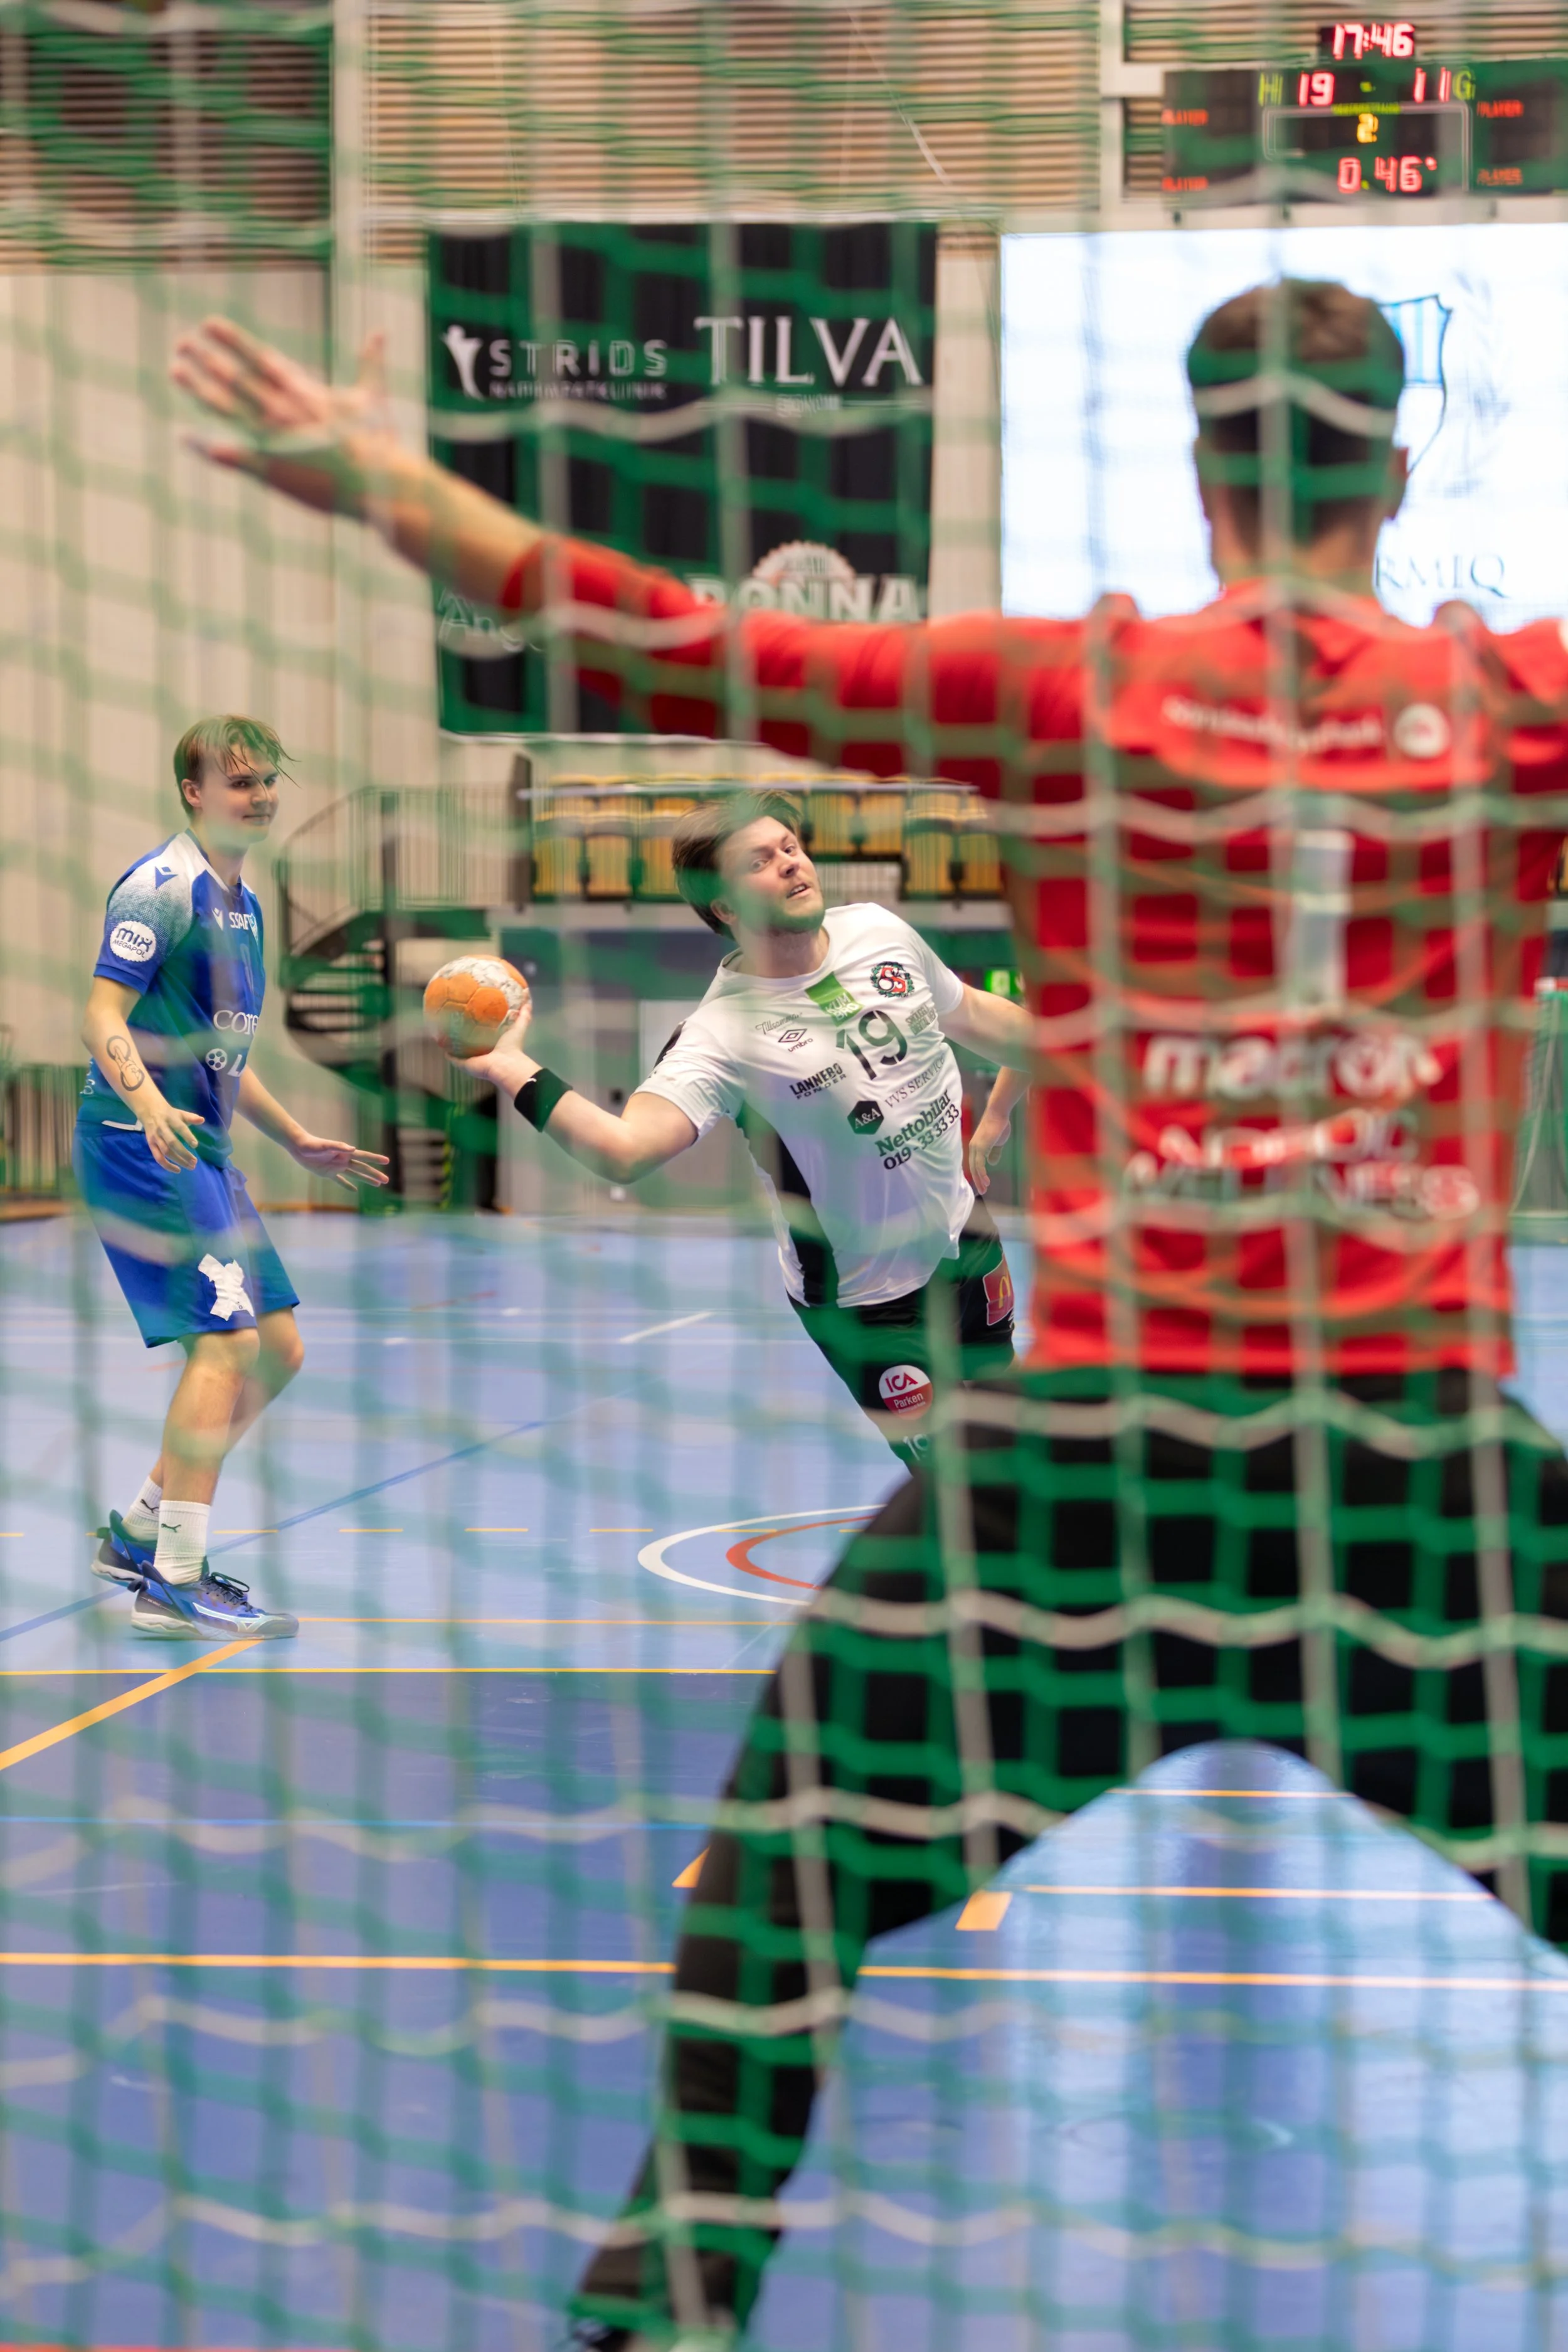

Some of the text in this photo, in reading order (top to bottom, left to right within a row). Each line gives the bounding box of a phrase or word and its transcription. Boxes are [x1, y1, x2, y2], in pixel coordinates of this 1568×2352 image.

[1333, 23, 1414, 60] 17:46
[1298, 72, 1334, 106] 19
[489, 339, 668, 376] STRIDS
[693, 315, 924, 386] TILVA
[113, 939, 146, 958] MEGAPOL
[788, 1038, 813, 1052] umbro
[835, 1010, 908, 1080] 19
[790, 1063, 843, 1096] LANNEBO
[797, 1074, 846, 1099] FONDER
[884, 1088, 908, 1108] VVS
[854, 1108, 881, 1129] A&A
[875, 1089, 951, 1157] Nettobilar
[883, 1147, 912, 1170] 019
[885, 1372, 919, 1393] ICA
[893, 1392, 924, 1409] Parken
